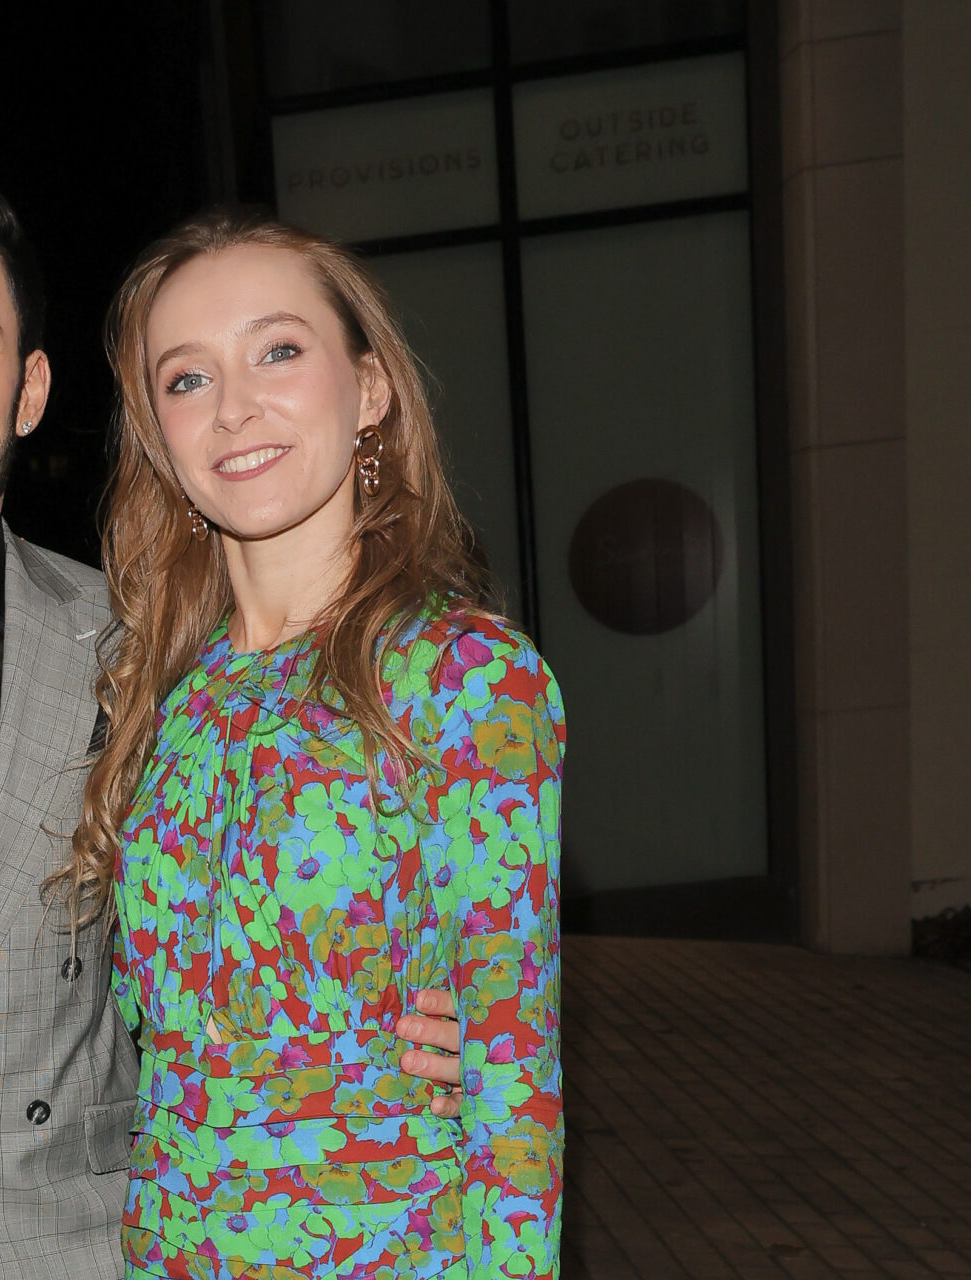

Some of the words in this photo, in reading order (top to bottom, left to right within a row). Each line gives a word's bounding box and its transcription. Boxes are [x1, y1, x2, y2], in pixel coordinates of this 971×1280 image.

[558, 103, 696, 142] OUTSIDE
[287, 148, 481, 193] PROVISIONS
[549, 132, 710, 173] CATERING
